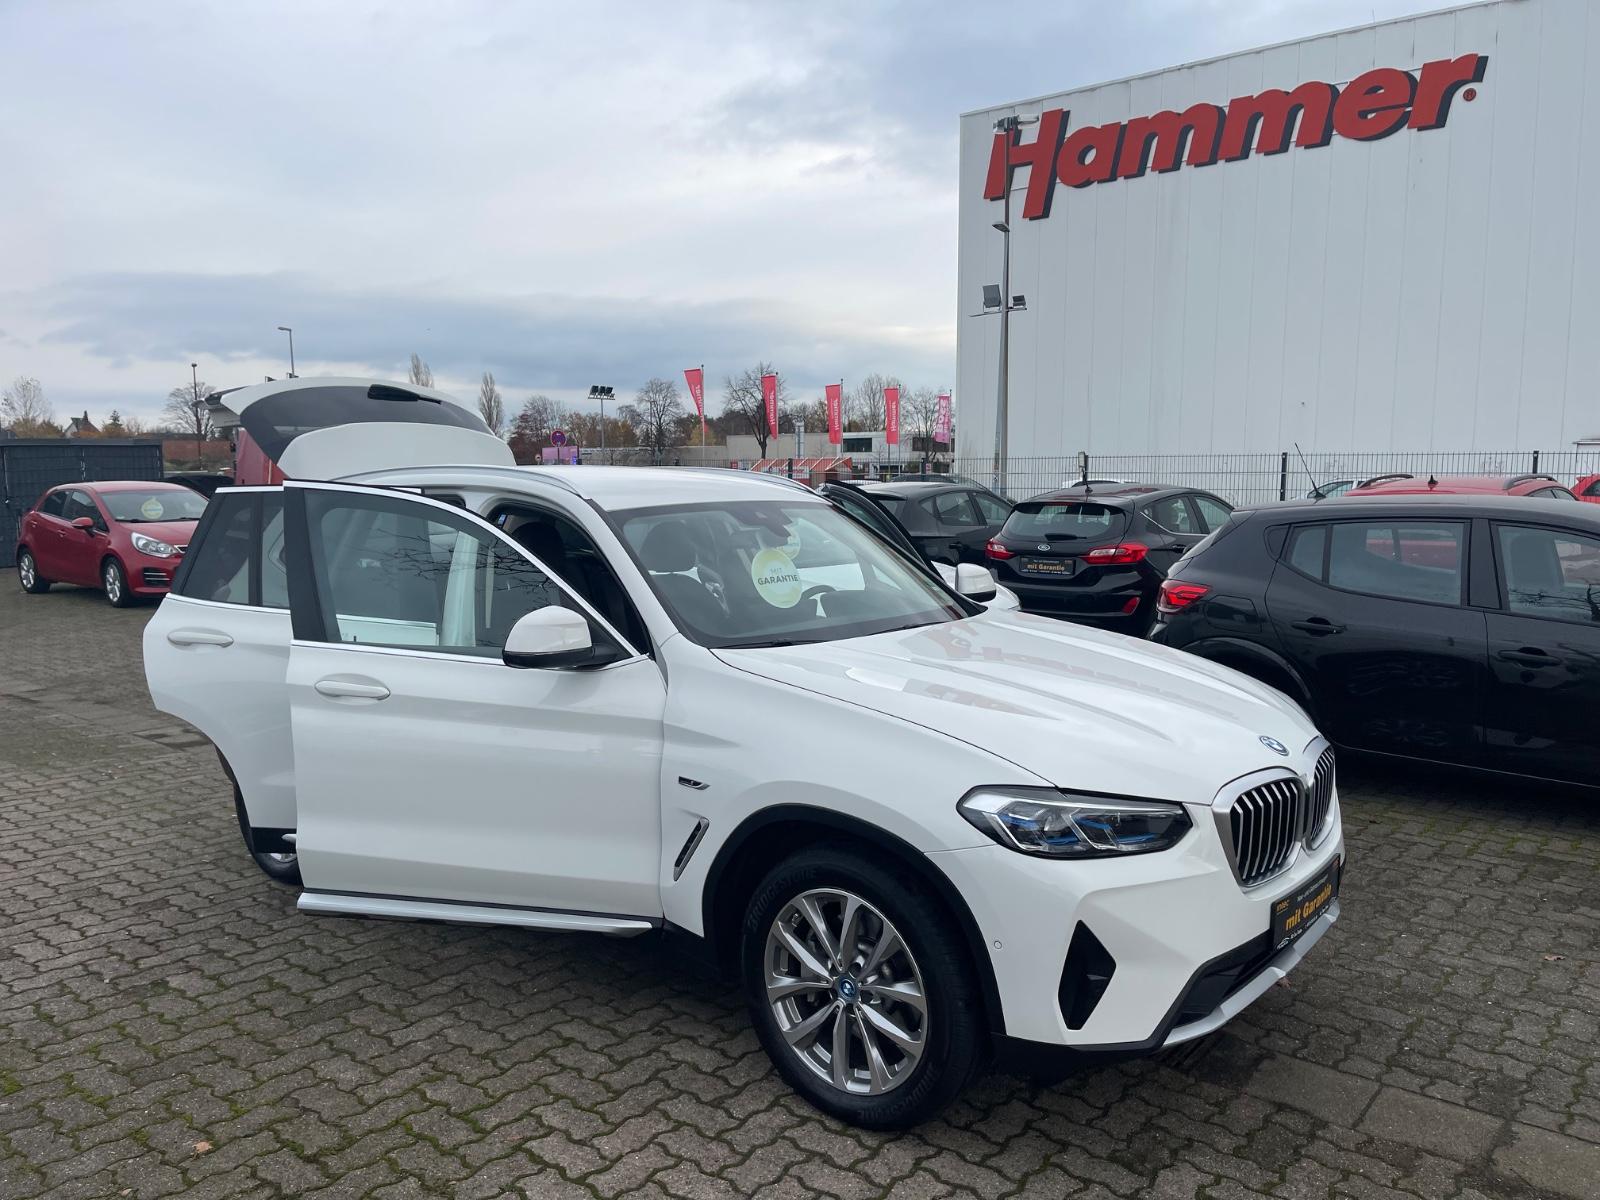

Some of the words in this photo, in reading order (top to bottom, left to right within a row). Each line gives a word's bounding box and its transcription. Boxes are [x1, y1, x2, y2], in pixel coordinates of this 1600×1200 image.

[983, 53, 1488, 220] Hammer
[757, 574, 799, 586] GARANTIE
[1286, 908, 1301, 931] mit
[1303, 883, 1332, 918] Garantie
